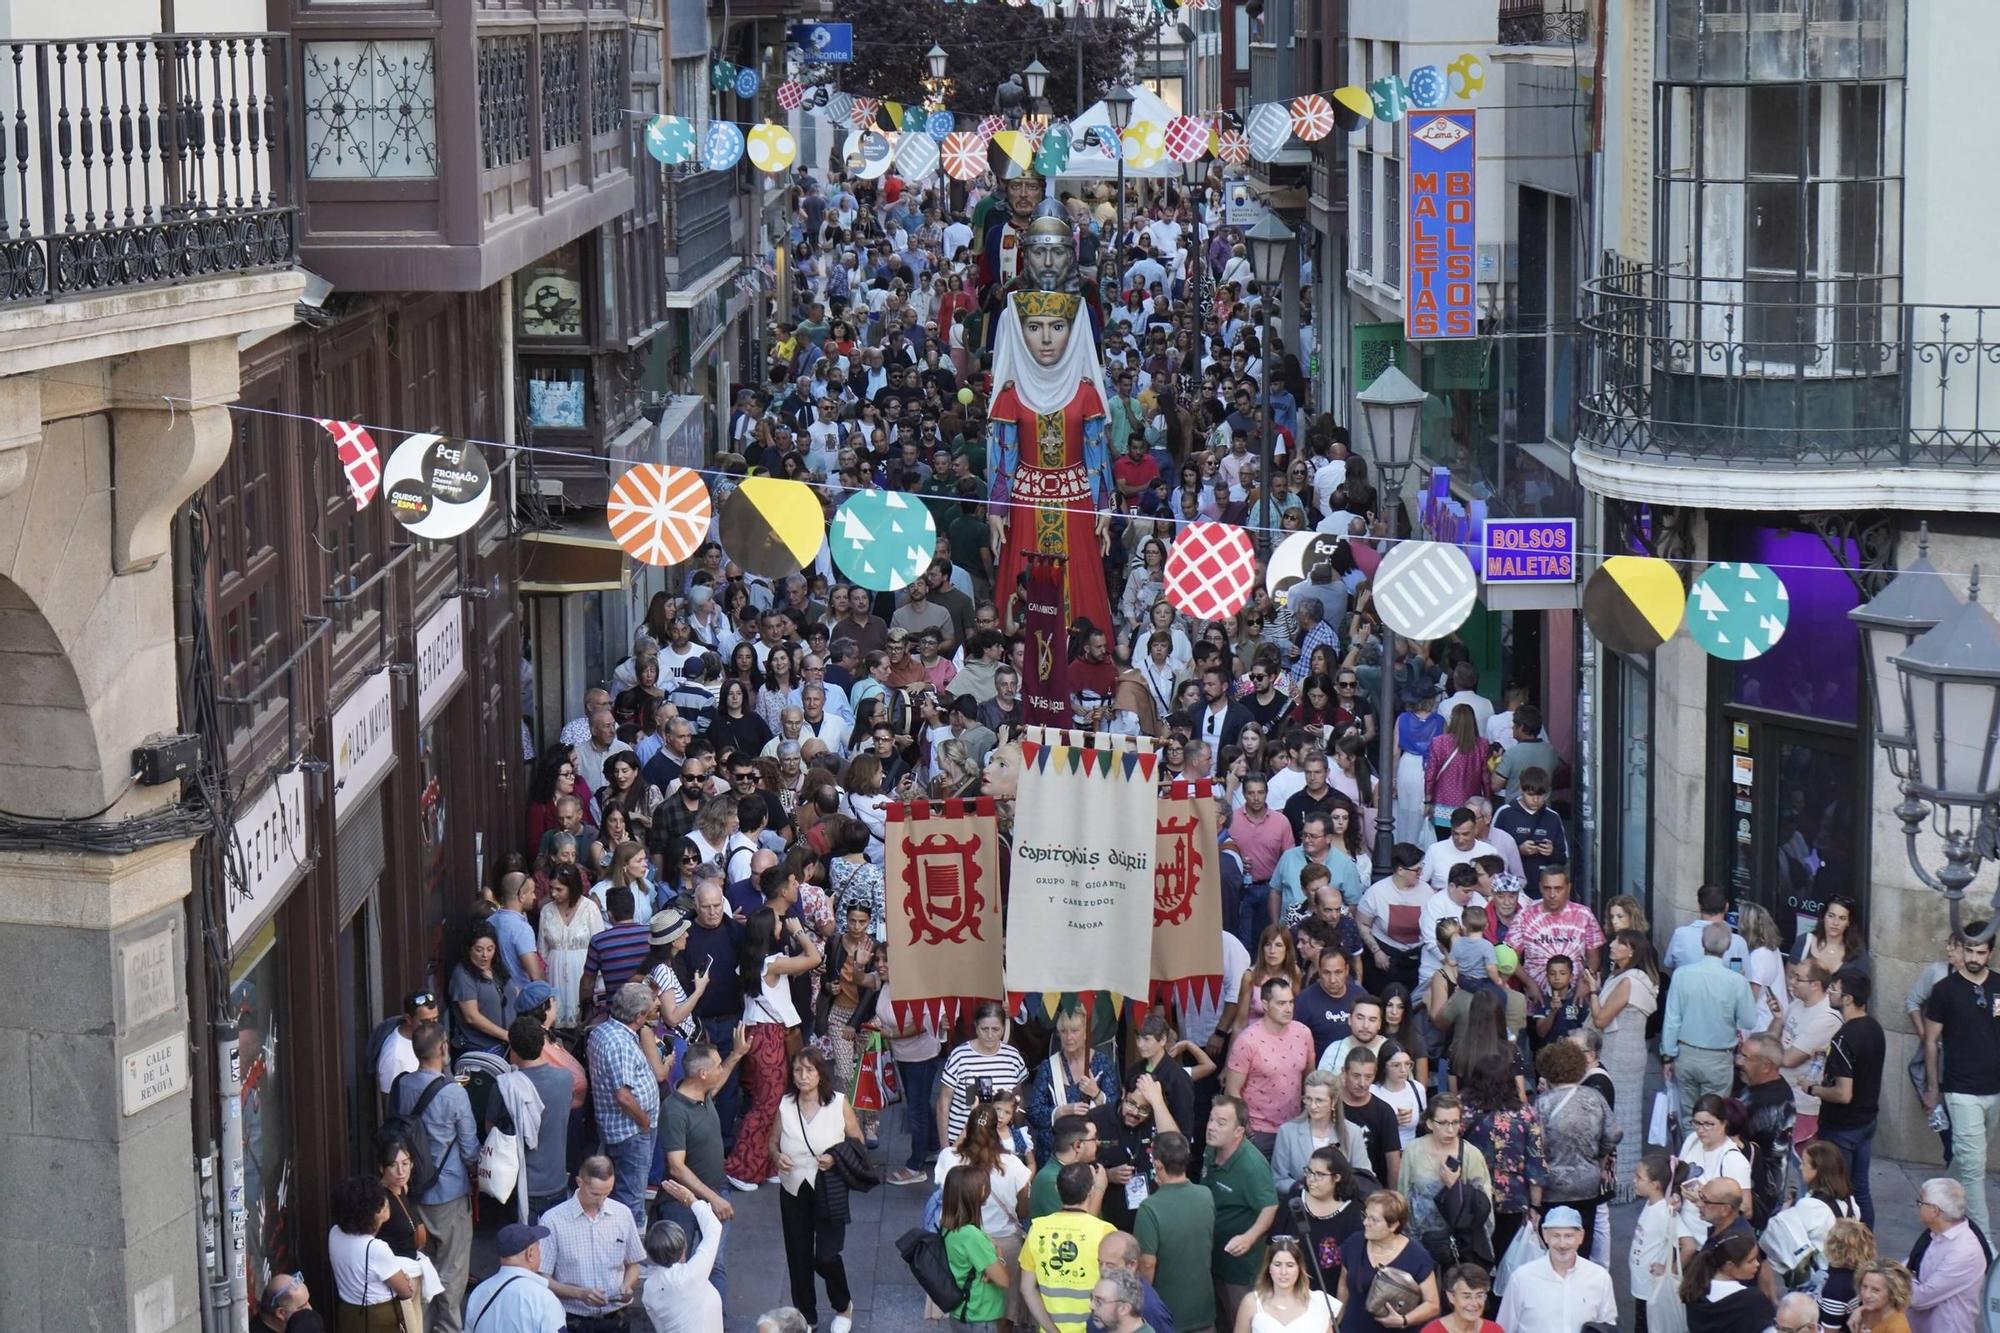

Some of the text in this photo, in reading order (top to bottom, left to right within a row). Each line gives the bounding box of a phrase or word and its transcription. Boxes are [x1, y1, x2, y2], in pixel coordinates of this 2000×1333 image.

[1423, 127, 1461, 140] Lema 3
[1412, 171, 1439, 334] MALETAS
[1445, 170, 1471, 334] BOLSOS
[392, 491, 423, 503] QUESOS
[1493, 528, 1566, 549] BOLSOS
[1488, 555, 1571, 576] MALETAS
[348, 692, 390, 770] PLAZA MAYOR
[1035, 877, 1065, 885] GRUPO
[1070, 879, 1080, 887] DE
[1048, 895, 1115, 907] Y CABEZUDOS
[1067, 920, 1104, 930] ZAMORA
[146, 1045, 172, 1067] CALLE
[143, 1063, 170, 1085] DE LA
[140, 1076, 173, 1101] RENOVA
